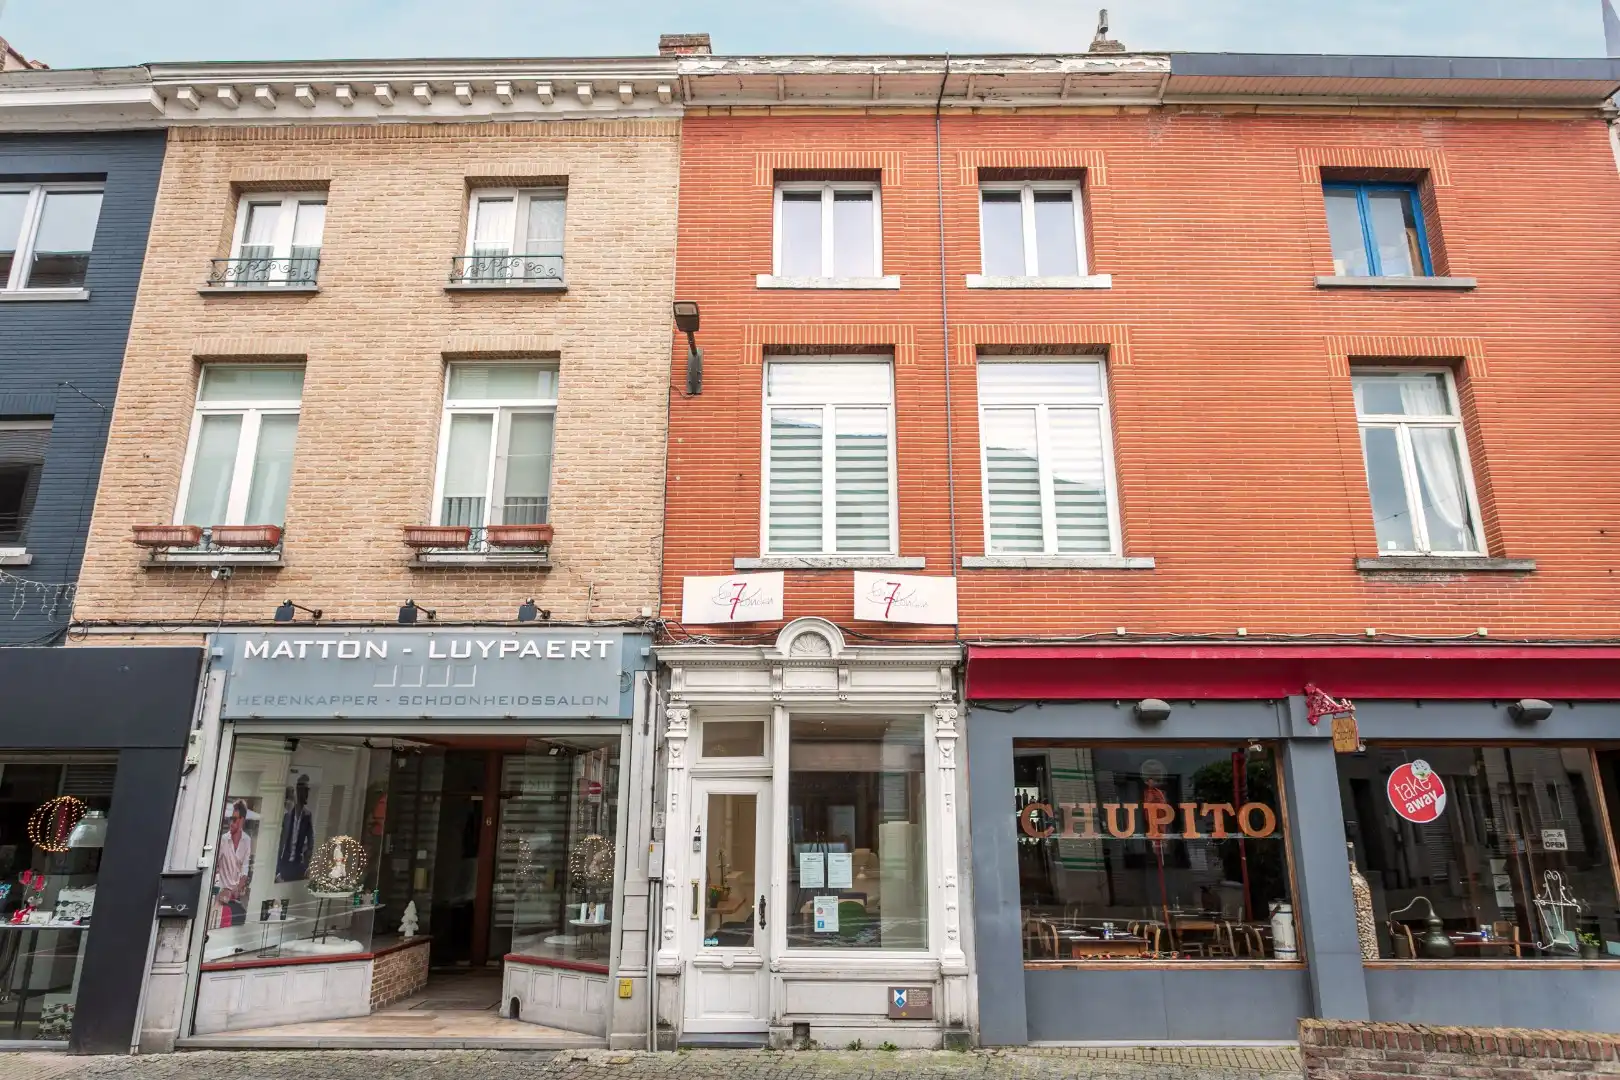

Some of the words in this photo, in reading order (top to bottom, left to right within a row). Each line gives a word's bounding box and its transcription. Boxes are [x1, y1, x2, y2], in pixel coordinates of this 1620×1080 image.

[730, 582, 747, 620] 7
[884, 582, 901, 619] 7
[243, 640, 388, 660] MATTON
[428, 640, 614, 660] LUYPAERT
[236, 695, 378, 706] HERENKAPPER
[398, 695, 609, 706] SCHOONHEIDSSALON
[1393, 776, 1432, 801] take
[1405, 789, 1438, 814] away
[1020, 802, 1277, 839] CHUPITO
[1545, 841, 1566, 849] OPEN
